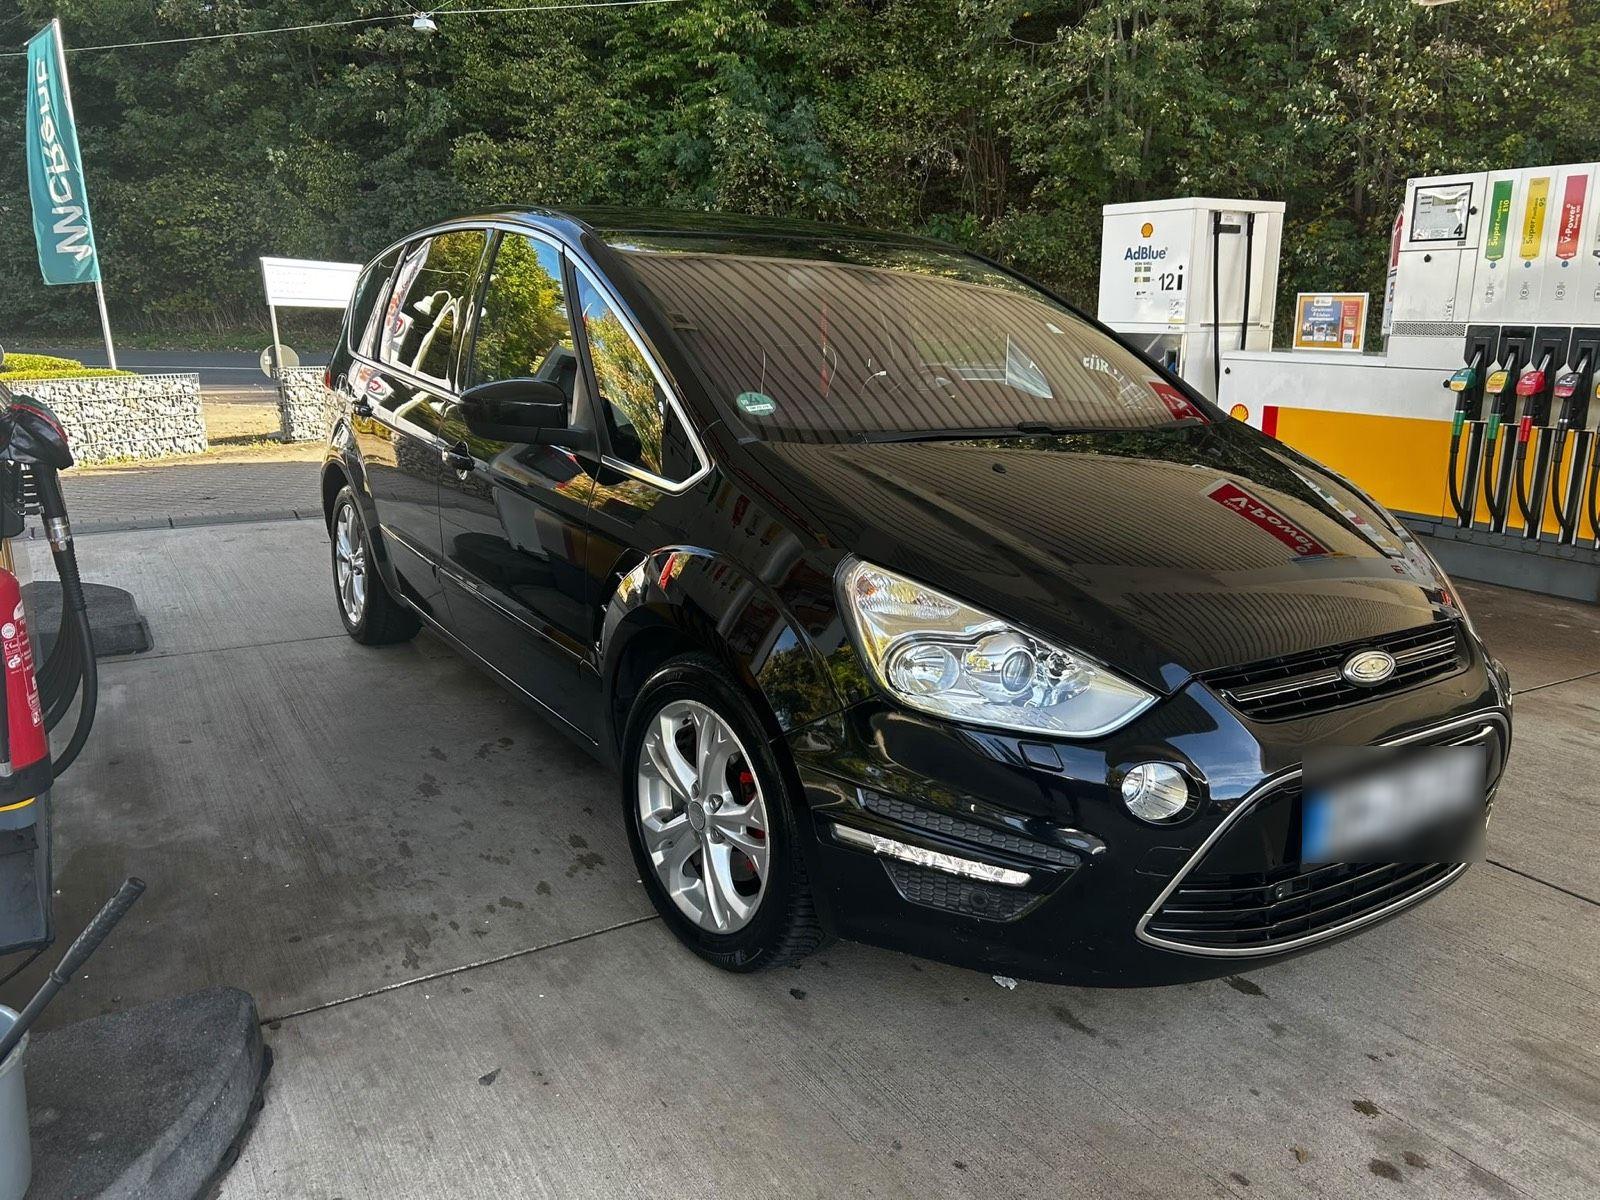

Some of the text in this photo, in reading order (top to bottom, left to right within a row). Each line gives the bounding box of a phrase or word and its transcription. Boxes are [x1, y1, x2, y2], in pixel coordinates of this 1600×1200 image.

[1502, 199, 1510, 212] E10
[1538, 197, 1546, 207] 95
[1453, 223, 1463, 237] 4
[1490, 221, 1501, 245] Super
[1526, 220, 1536, 244] Super
[1158, 272, 1174, 291] 12
